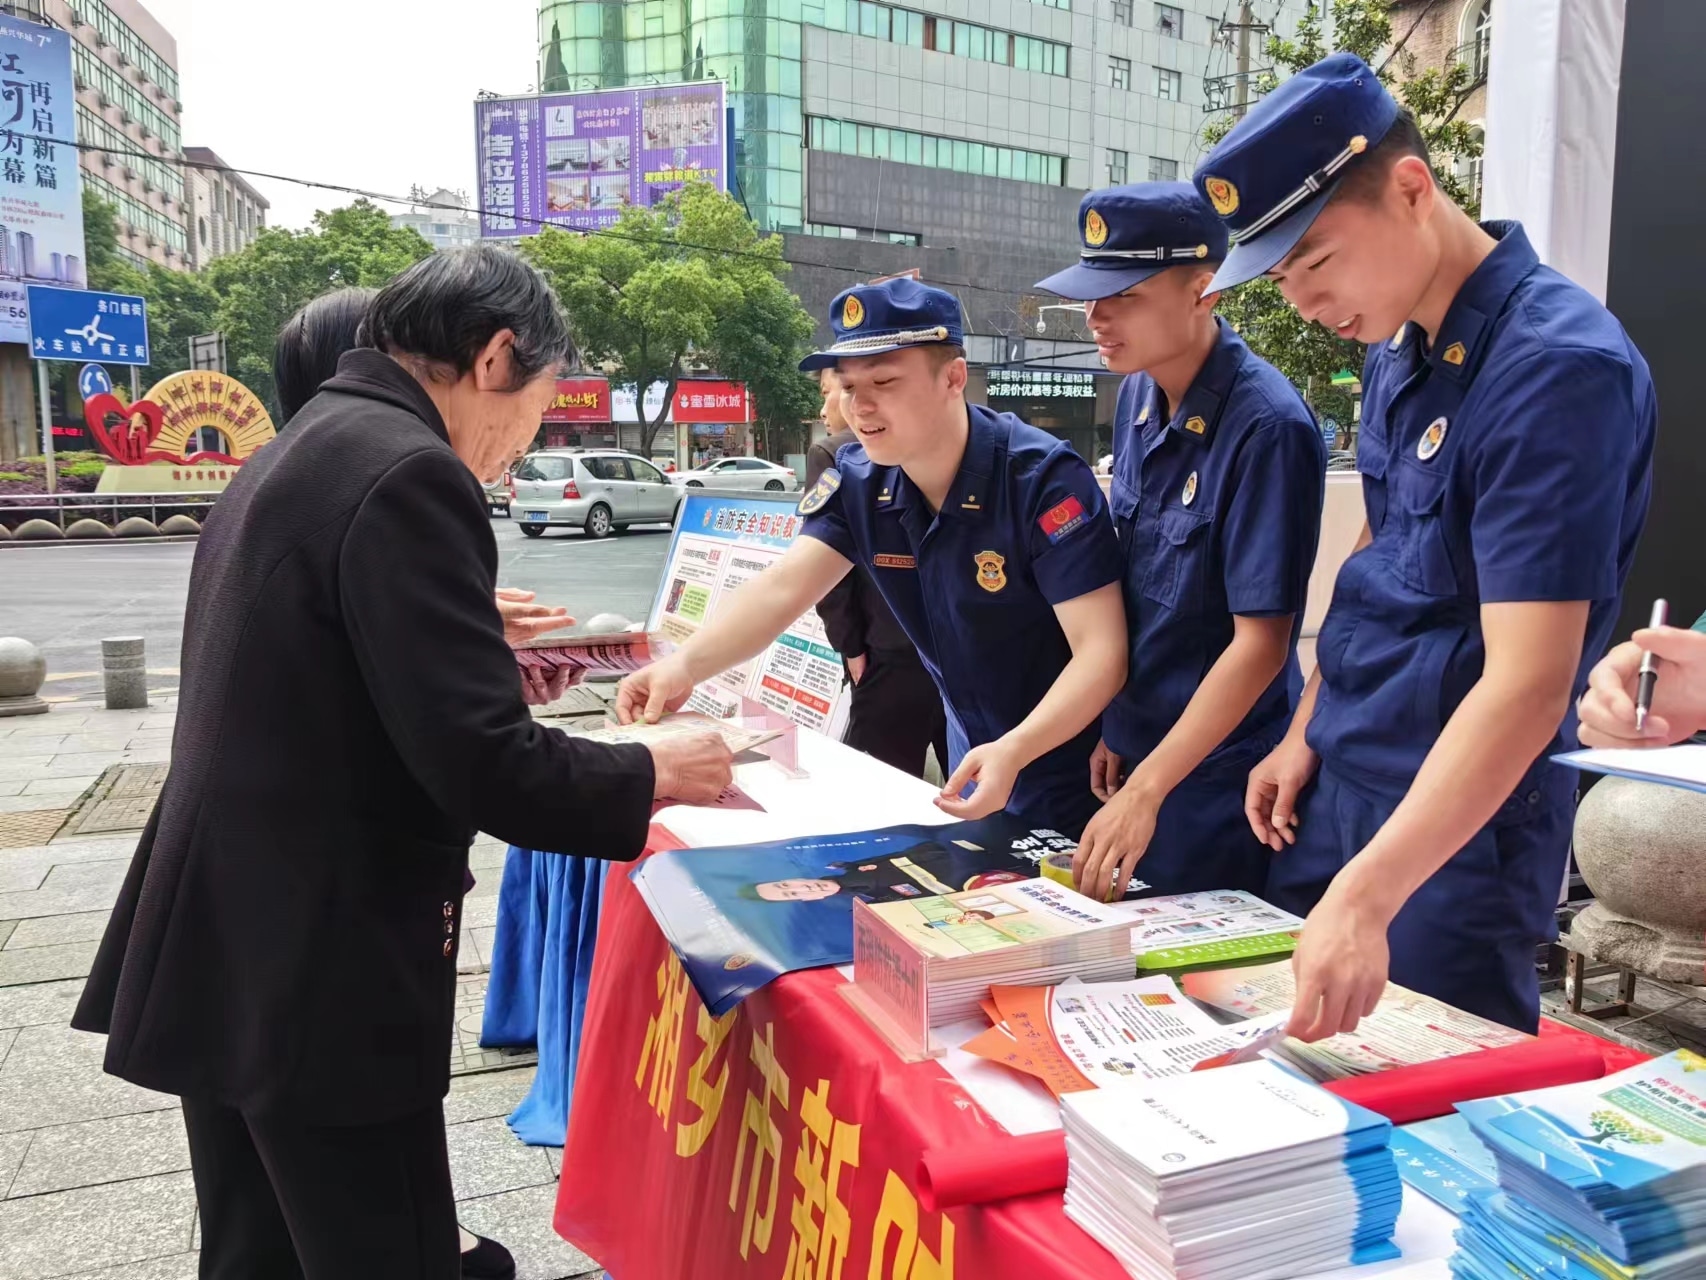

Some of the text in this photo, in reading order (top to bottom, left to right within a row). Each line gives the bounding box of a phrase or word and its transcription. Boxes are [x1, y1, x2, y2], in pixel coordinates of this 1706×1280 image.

[28, 80, 57, 190] 再启新篇
[483, 108, 517, 230] 广告位招租
[34, 337, 83, 354] 火车站
[690, 394, 741, 408] 蜜雪冰城
